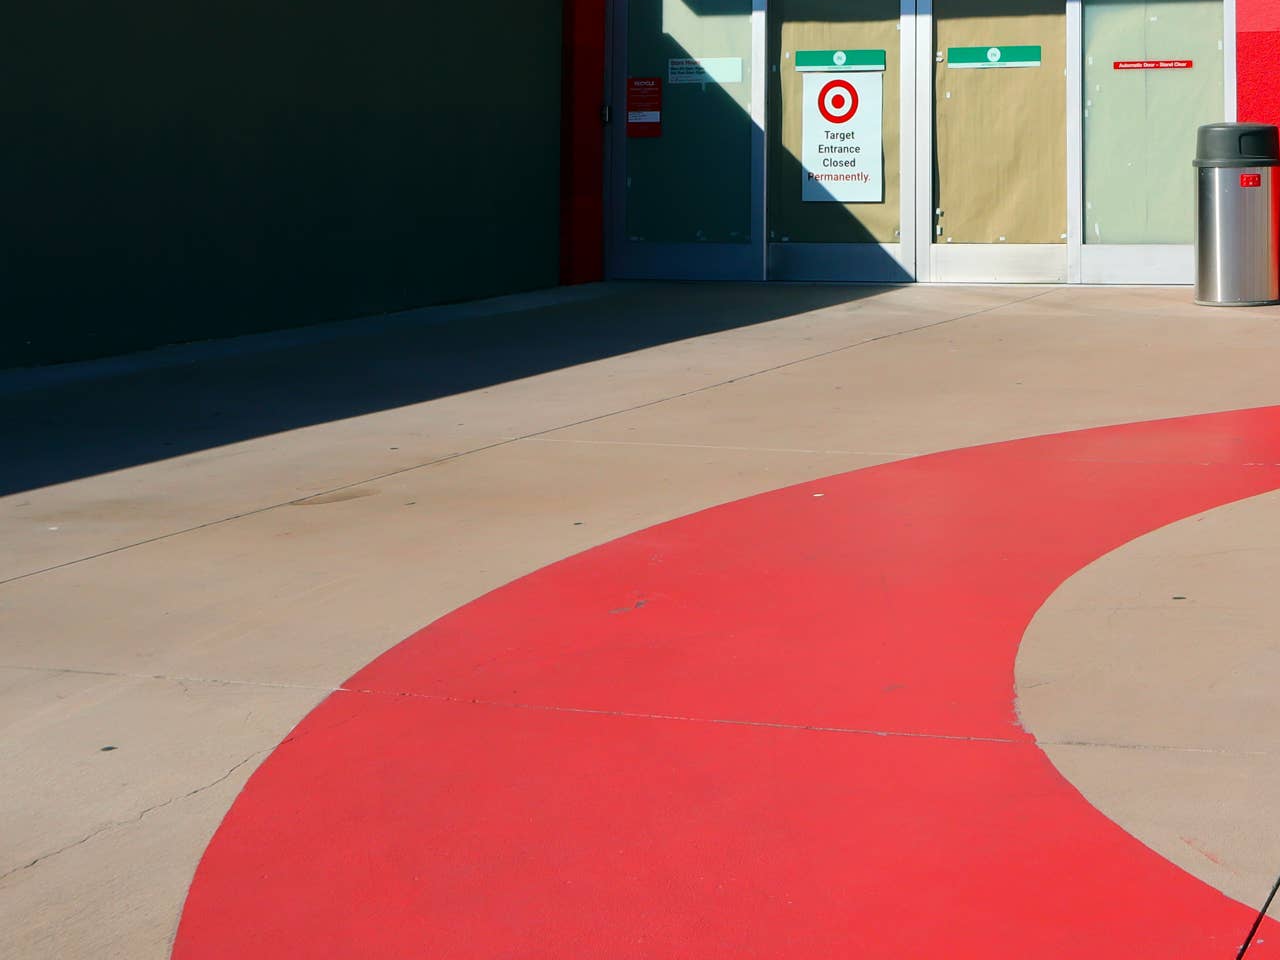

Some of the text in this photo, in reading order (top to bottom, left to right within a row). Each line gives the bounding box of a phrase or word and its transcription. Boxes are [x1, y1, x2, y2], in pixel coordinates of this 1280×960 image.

[824, 130, 855, 141] Target
[818, 144, 861, 154] Entrance
[822, 157, 856, 167] Closed
[807, 171, 871, 183] Permanently.
